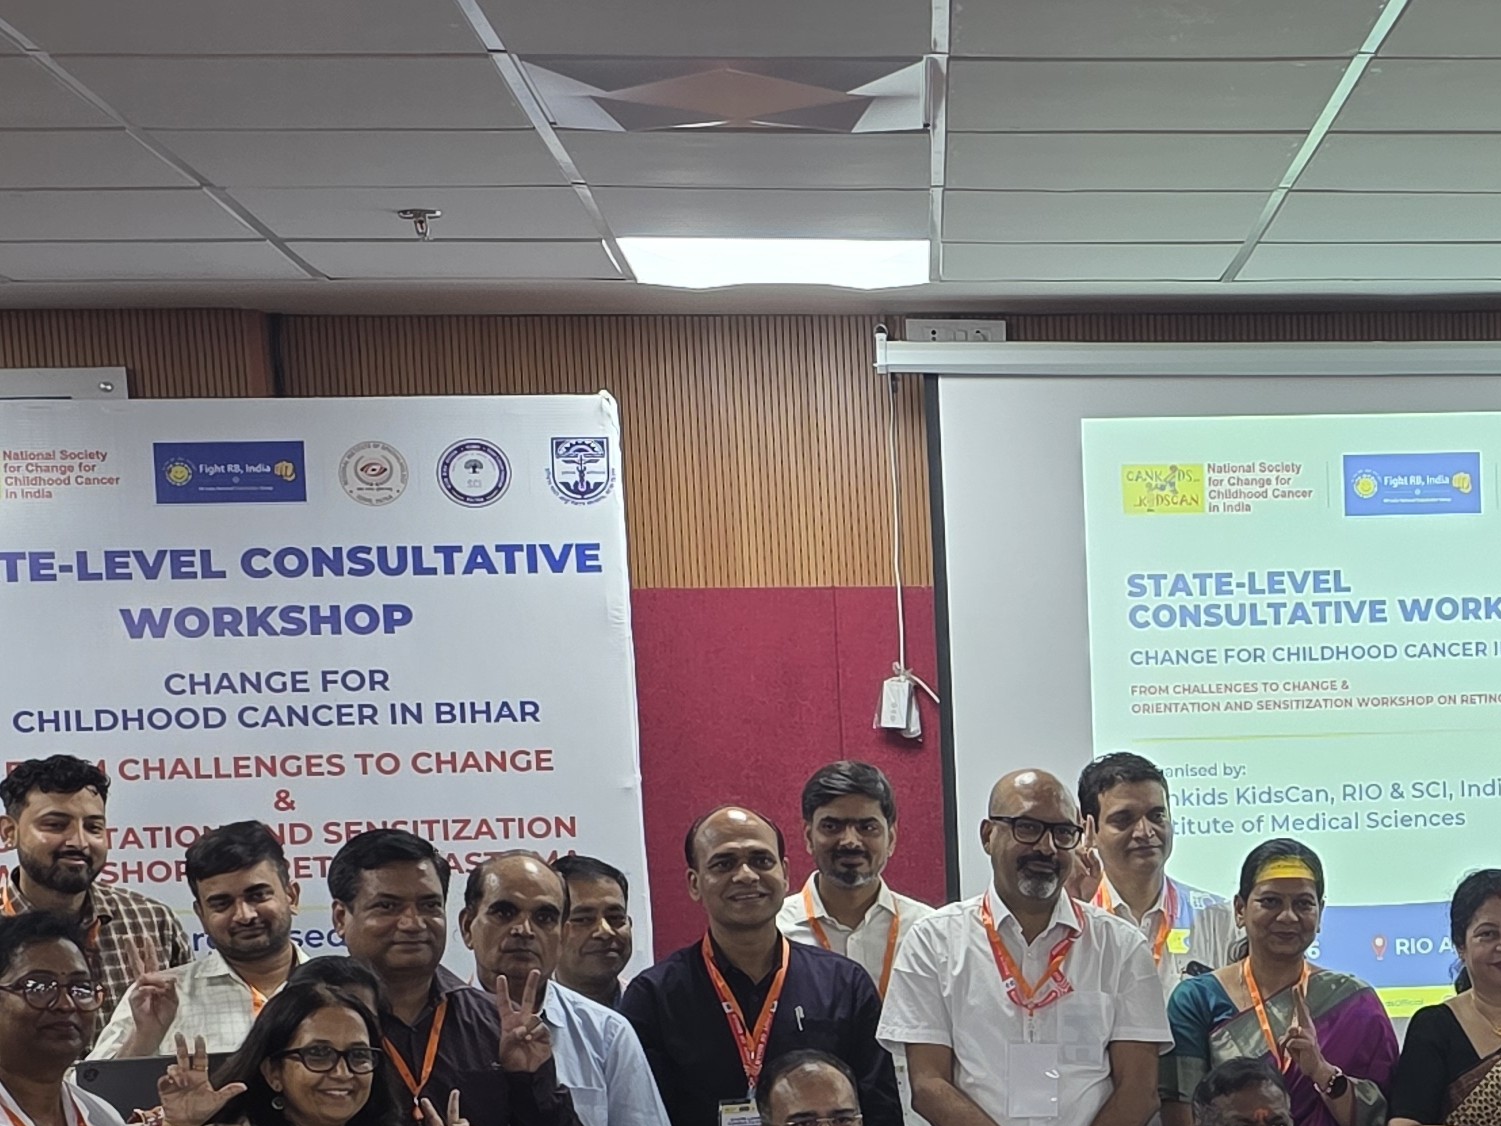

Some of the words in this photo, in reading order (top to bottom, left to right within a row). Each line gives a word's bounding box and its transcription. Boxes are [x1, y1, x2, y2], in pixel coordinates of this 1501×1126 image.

[3, 450, 56, 460] National
[59, 449, 107, 462] Society
[4, 462, 22, 473] for
[25, 463, 74, 475] Change
[78, 462, 97, 472] for
[245, 463, 271, 473] India
[1207, 463, 1256, 474] National
[1258, 462, 1302, 475] Society
[5, 475, 71, 486] Childhood
[75, 474, 120, 485] Cancer
[1208, 477, 1224, 487] for
[1227, 476, 1273, 488] Change
[1275, 475, 1292, 486] for
[5, 488, 17, 499] in
[21, 488, 53, 499] India
[1208, 489, 1268, 500] Childhood
[1272, 488, 1313, 499] Cancer
[1208, 502, 1220, 513] in
[1222, 502, 1252, 513] India
[240, 542, 603, 579] CONSULTATIVE
[1127, 569, 1352, 598] STATE-LEVEL
[119, 603, 413, 639] WORKSHOP
[1128, 599, 1388, 629] CONSULTATIVE
[1130, 648, 1218, 666] CHANGE
[1224, 647, 1266, 664] FOR
[1272, 644, 1398, 663] CHILDHOOD
[1404, 641, 1488, 659] CANCER
[164, 671, 310, 695] CHANGE
[321, 669, 390, 692] FOR
[1131, 685, 1169, 696] FROM
[1173, 682, 1258, 695] CHALLENGES
[1261, 681, 1279, 693] TO
[1283, 680, 1337, 692] CHANGE
[1341, 679, 1349, 690] &
[1131, 701, 1221, 714] ORIENTATION
[1224, 700, 1253, 712] AND
[1256, 698, 1353, 711] SENSITIZATION
[1357, 695, 1434, 708] WORKSHOP
[1437, 694, 1457, 706] ON
[12, 706, 227, 733] CHILDHOOD
[237, 703, 379, 728] CANCER
[390, 702, 423, 725] IN
[435, 700, 541, 724] BIHAR
[118, 753, 346, 781] CHALLENGES
[354, 752, 401, 775] TO
[411, 749, 554, 774] CHANGE
[1164, 763, 1218, 778] anised
[1223, 762, 1246, 780] by:
[274, 789, 296, 811] &
[1169, 787, 1229, 807] nkids
[1236, 785, 1335, 806] KidsCan,
[1342, 783, 1382, 802] RIO
[1390, 782, 1405, 800] &
[1411, 780, 1454, 801] SCI,
[1172, 815, 1234, 836] titute
[1241, 814, 1264, 834] of
[1271, 811, 1360, 833] Medical
[1366, 809, 1466, 830] Sciences
[1395, 937, 1433, 956] RIO
